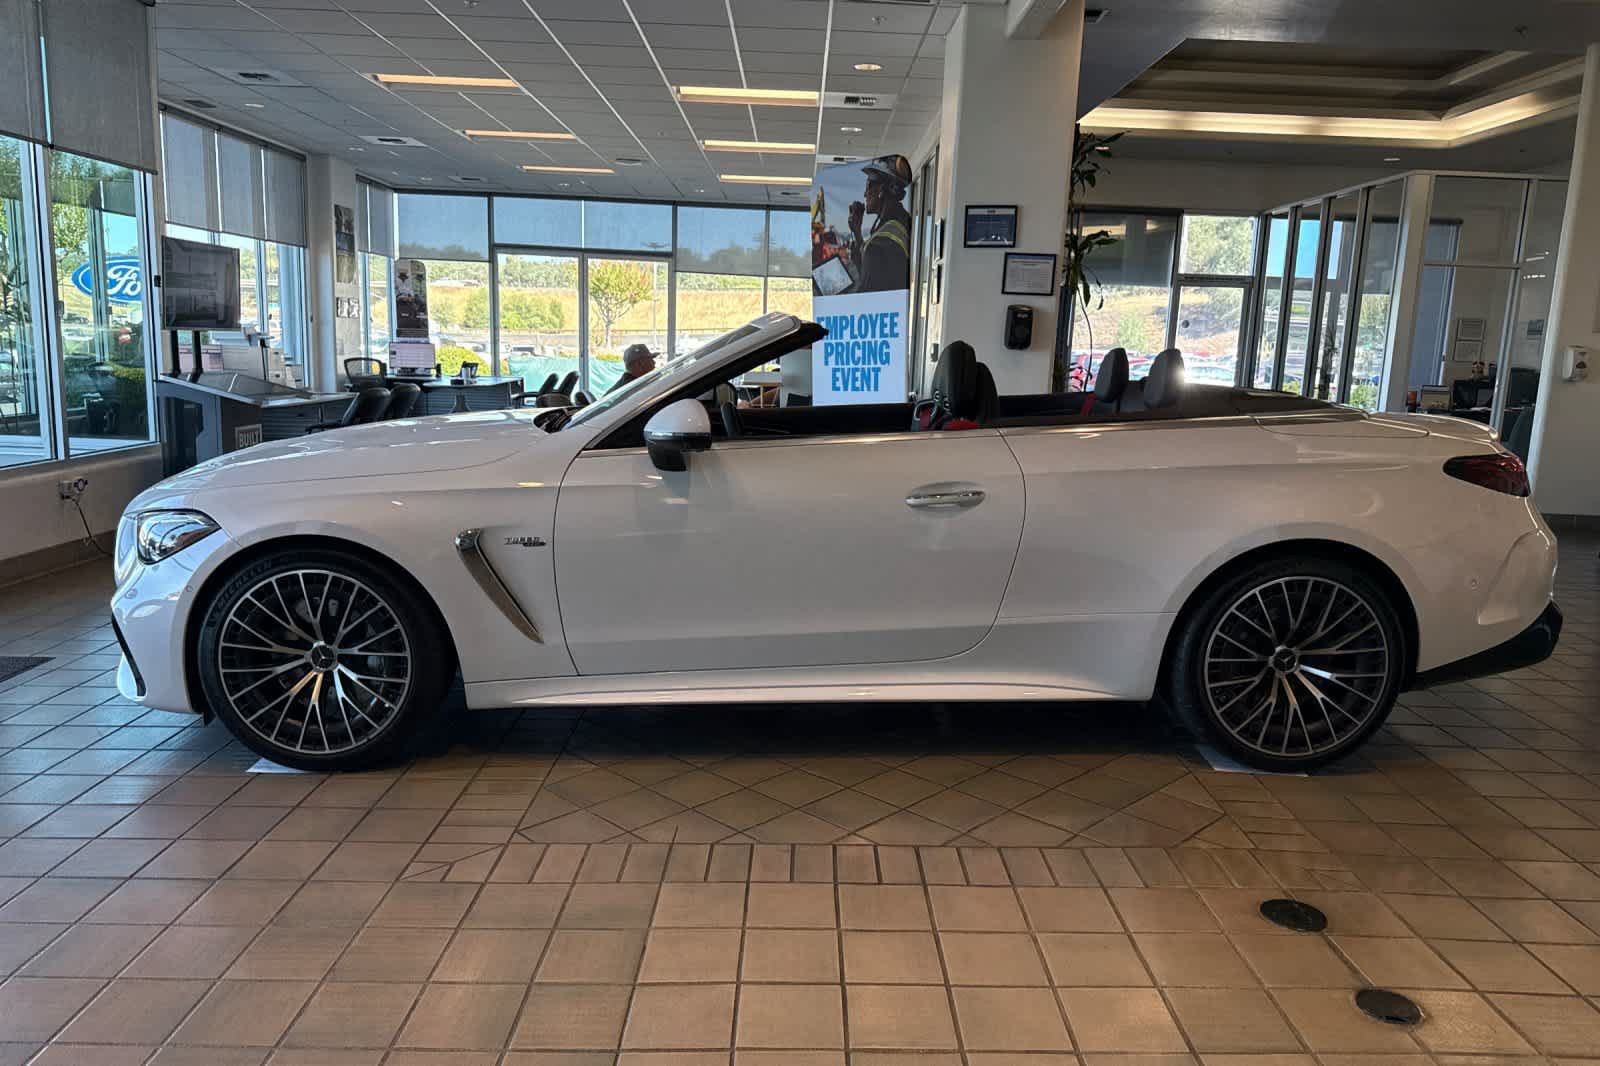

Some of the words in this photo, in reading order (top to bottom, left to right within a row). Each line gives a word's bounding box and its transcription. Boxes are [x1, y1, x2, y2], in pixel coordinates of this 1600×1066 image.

[106, 264, 142, 296] Fo
[824, 340, 890, 366] PRICING
[831, 367, 881, 392] EVENT
